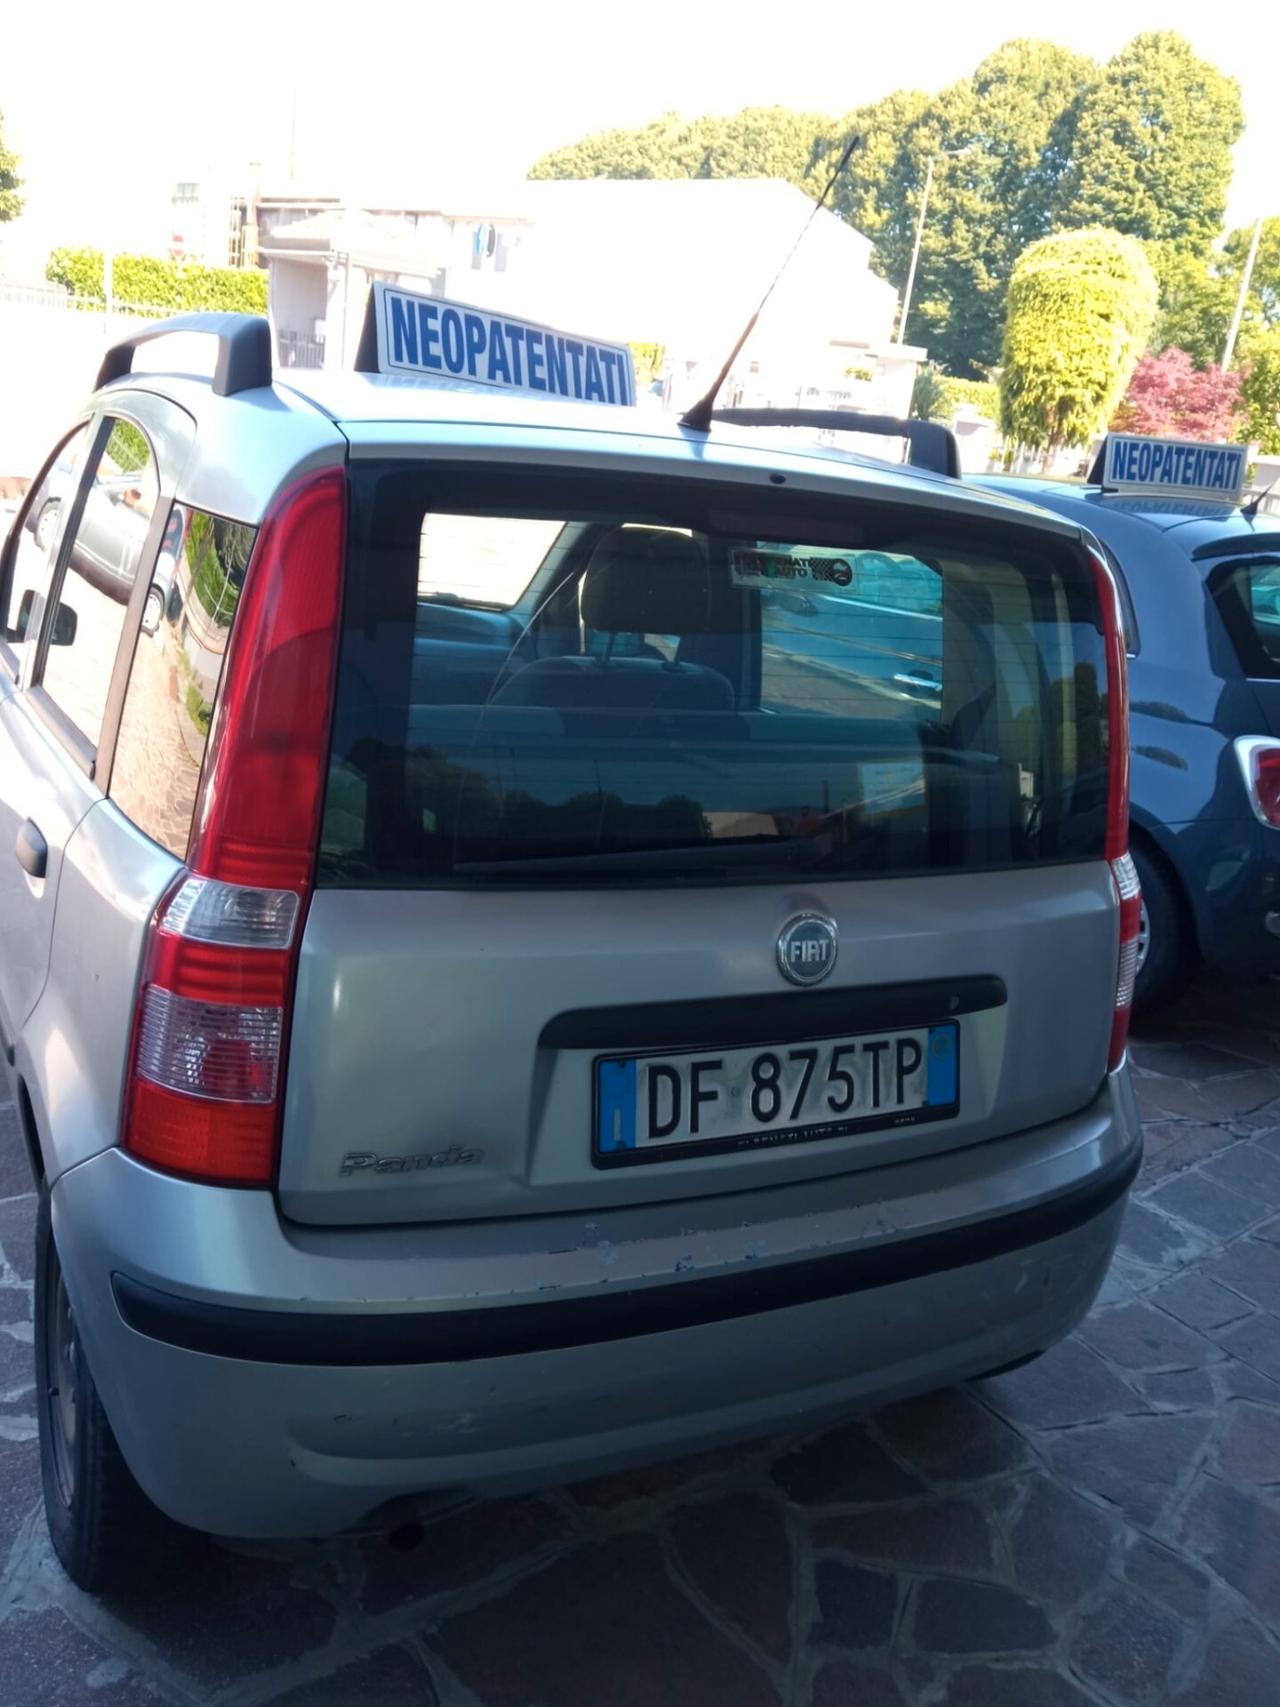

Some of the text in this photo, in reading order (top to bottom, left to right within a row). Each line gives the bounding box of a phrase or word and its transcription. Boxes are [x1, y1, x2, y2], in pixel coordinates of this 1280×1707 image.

[391, 297, 628, 407] NEOPATENTATI
[1112, 441, 1242, 491] NEOPATENTATI
[790, 939, 830, 963] FIAT
[648, 1062, 723, 1139] DF
[750, 1037, 923, 1123] 875TP
[338, 1145, 485, 1177] Panda
